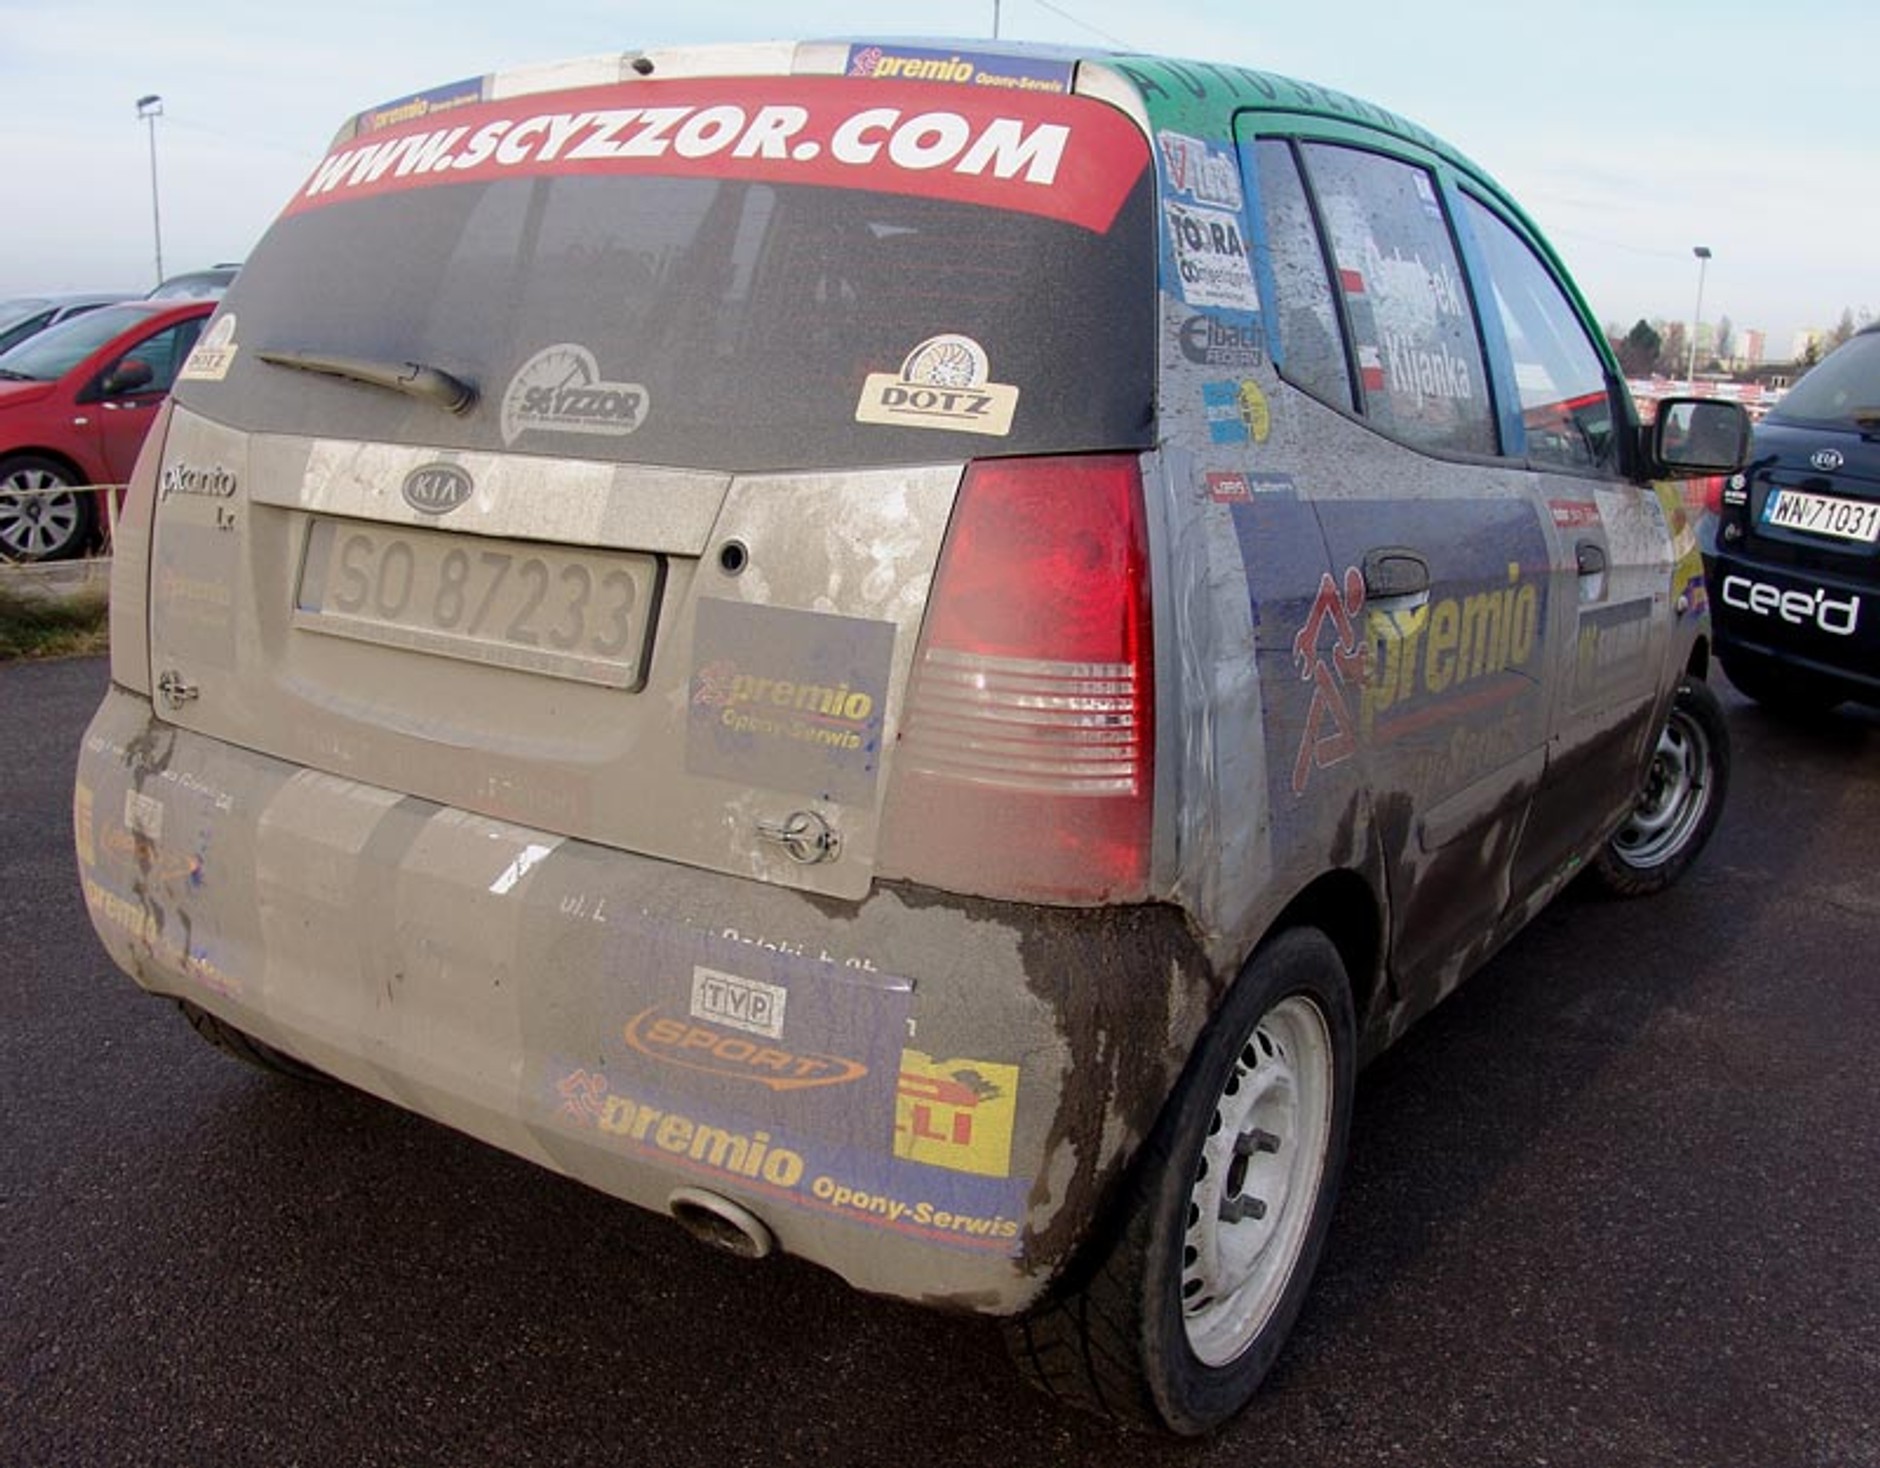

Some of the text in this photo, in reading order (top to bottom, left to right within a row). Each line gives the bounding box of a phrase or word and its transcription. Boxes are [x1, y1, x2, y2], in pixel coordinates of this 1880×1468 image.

[874, 56, 973, 82] premio
[305, 105, 1070, 197] WWW.SCYZZOR.COM
[882, 387, 993, 415] DOTZ
[414, 474, 458, 502] KIA
[1775, 490, 1808, 525] WN
[1810, 499, 1877, 537] 71031
[337, 534, 415, 618] SO
[437, 547, 636, 657] 87233
[1723, 575, 1860, 635] cee'd
[1363, 563, 1538, 738] premio
[731, 675, 872, 720] premio
[704, 981, 770, 1020] TVP
[647, 1018, 829, 1078] SPORT
[896, 1104, 971, 1146] LI
[601, 1092, 1018, 1239] premio Opony-Serwis
